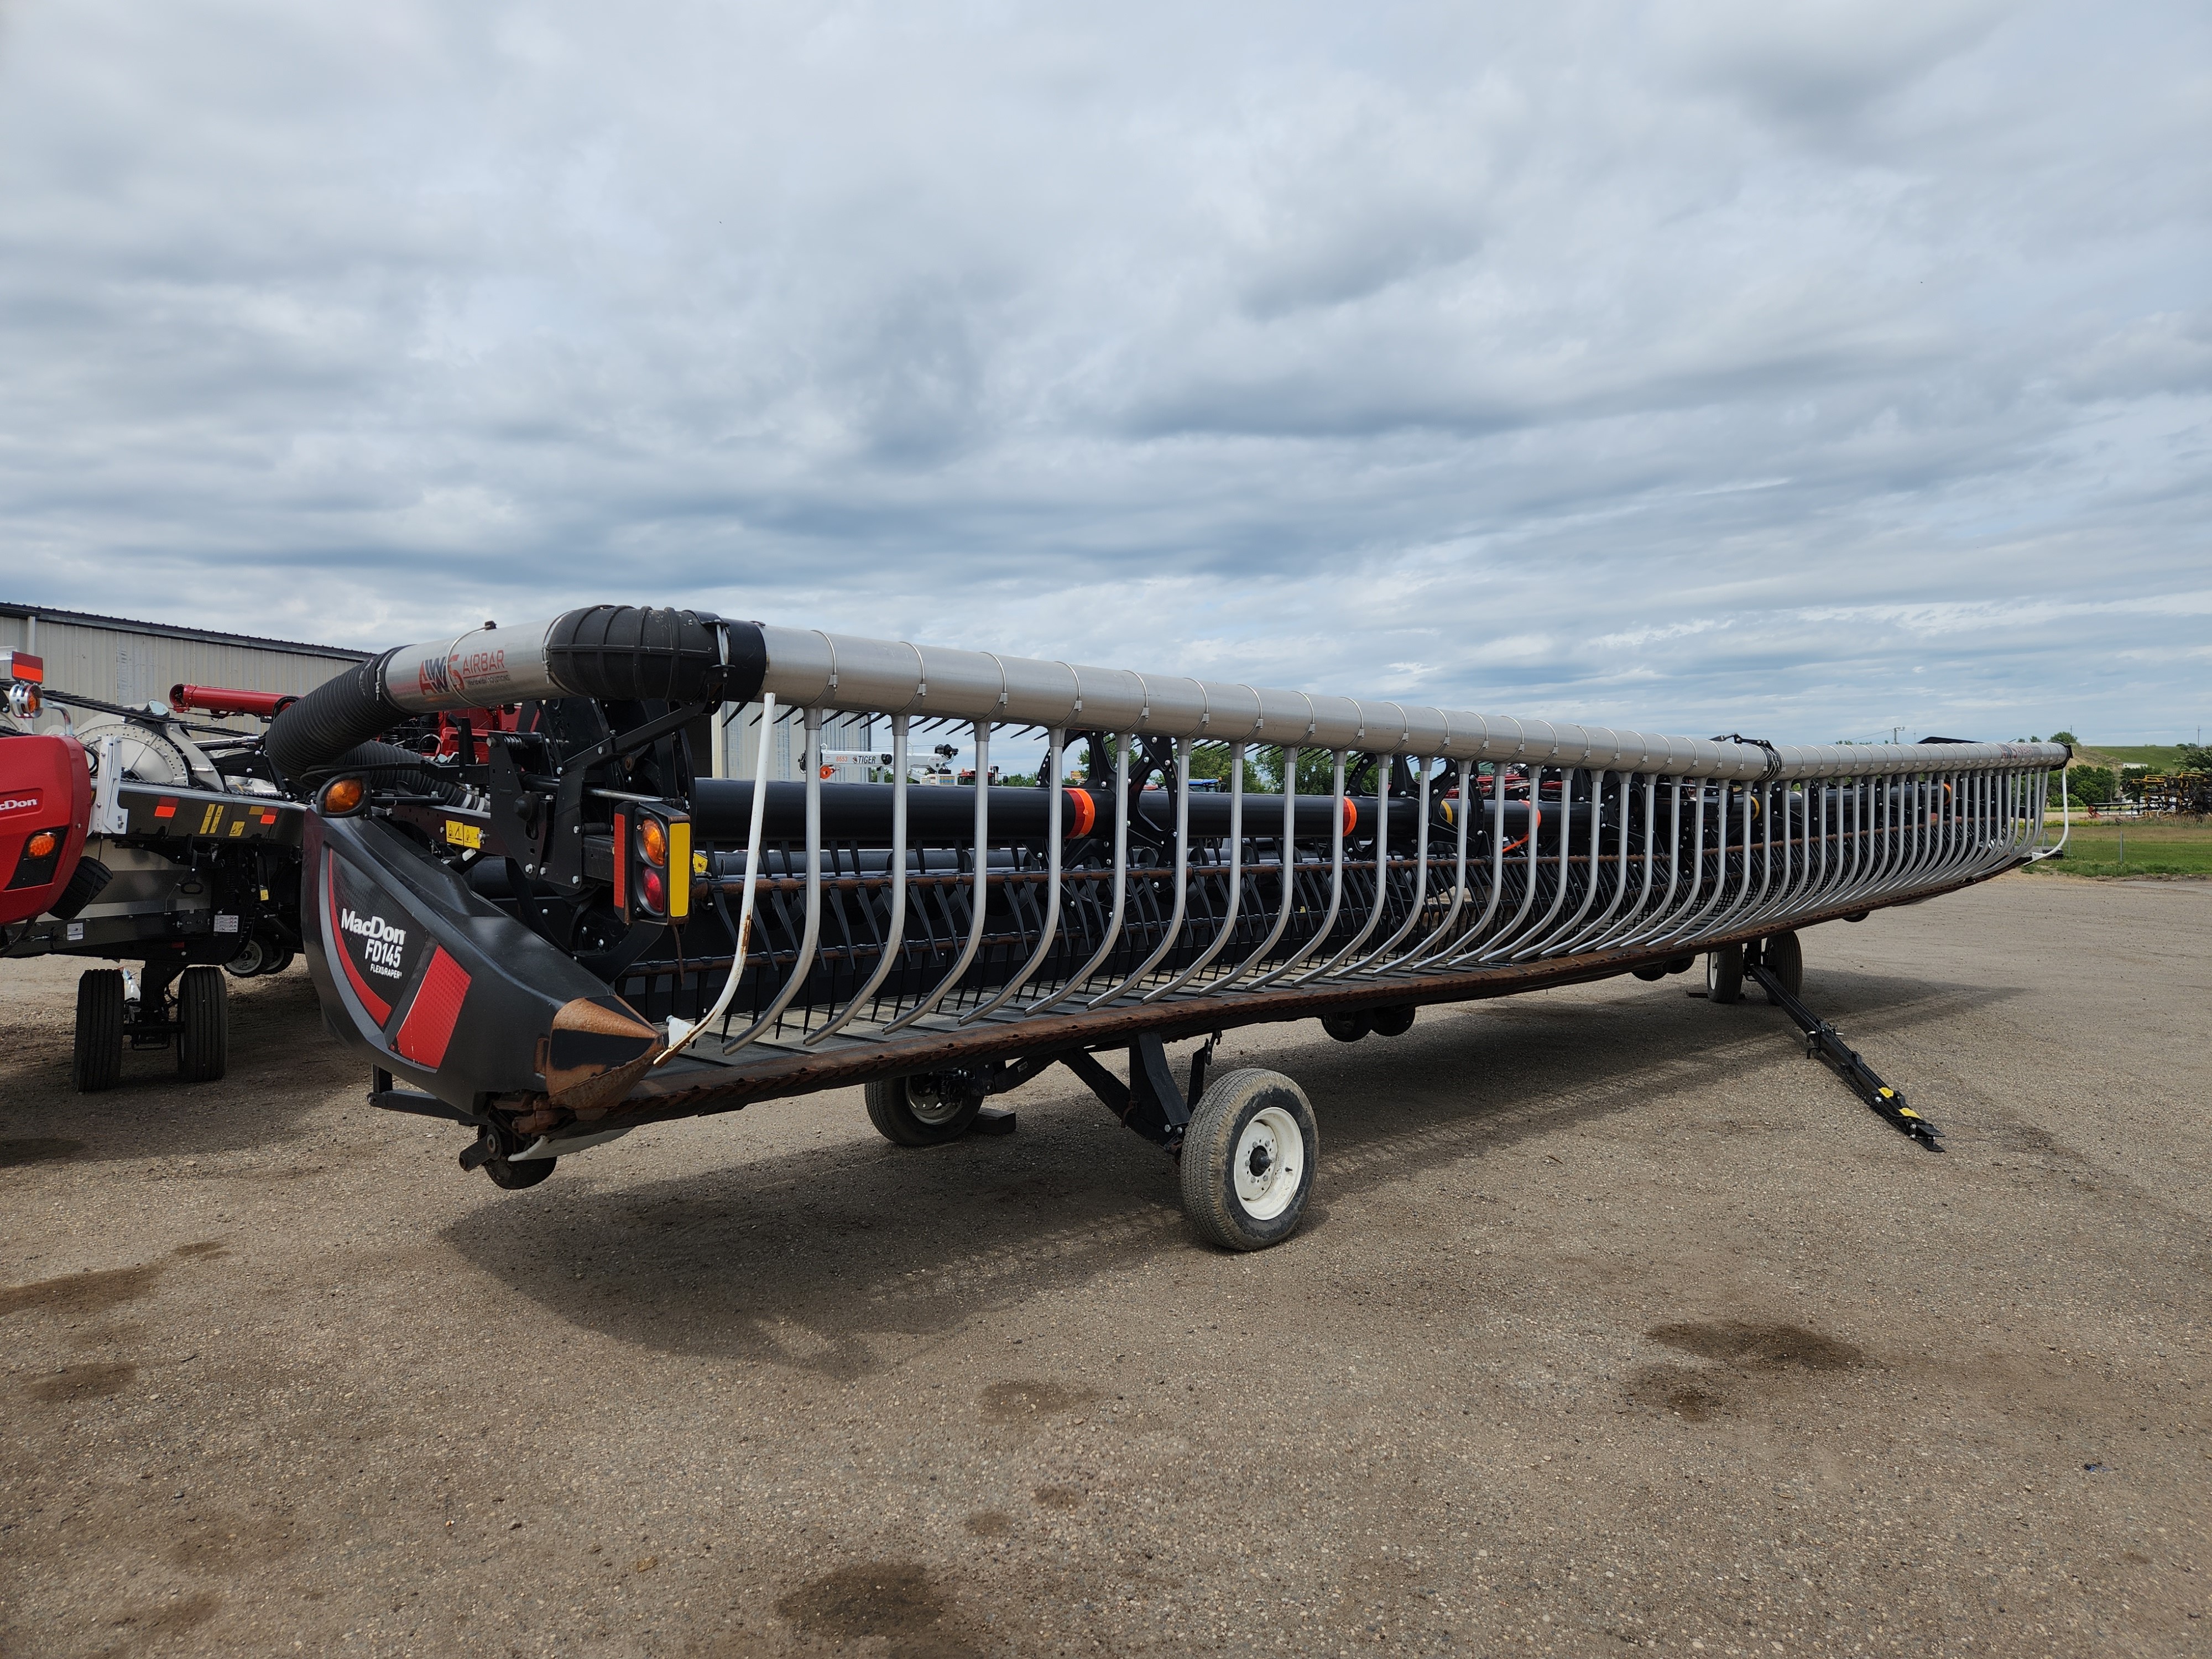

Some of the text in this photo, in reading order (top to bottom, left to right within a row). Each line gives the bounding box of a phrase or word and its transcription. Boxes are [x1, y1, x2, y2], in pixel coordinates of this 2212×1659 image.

[463, 650, 504, 675] AIRBAR
[858, 755, 876, 764] TIGER
[341, 908, 406, 946] MacDon
[365, 938, 403, 968] FD145
